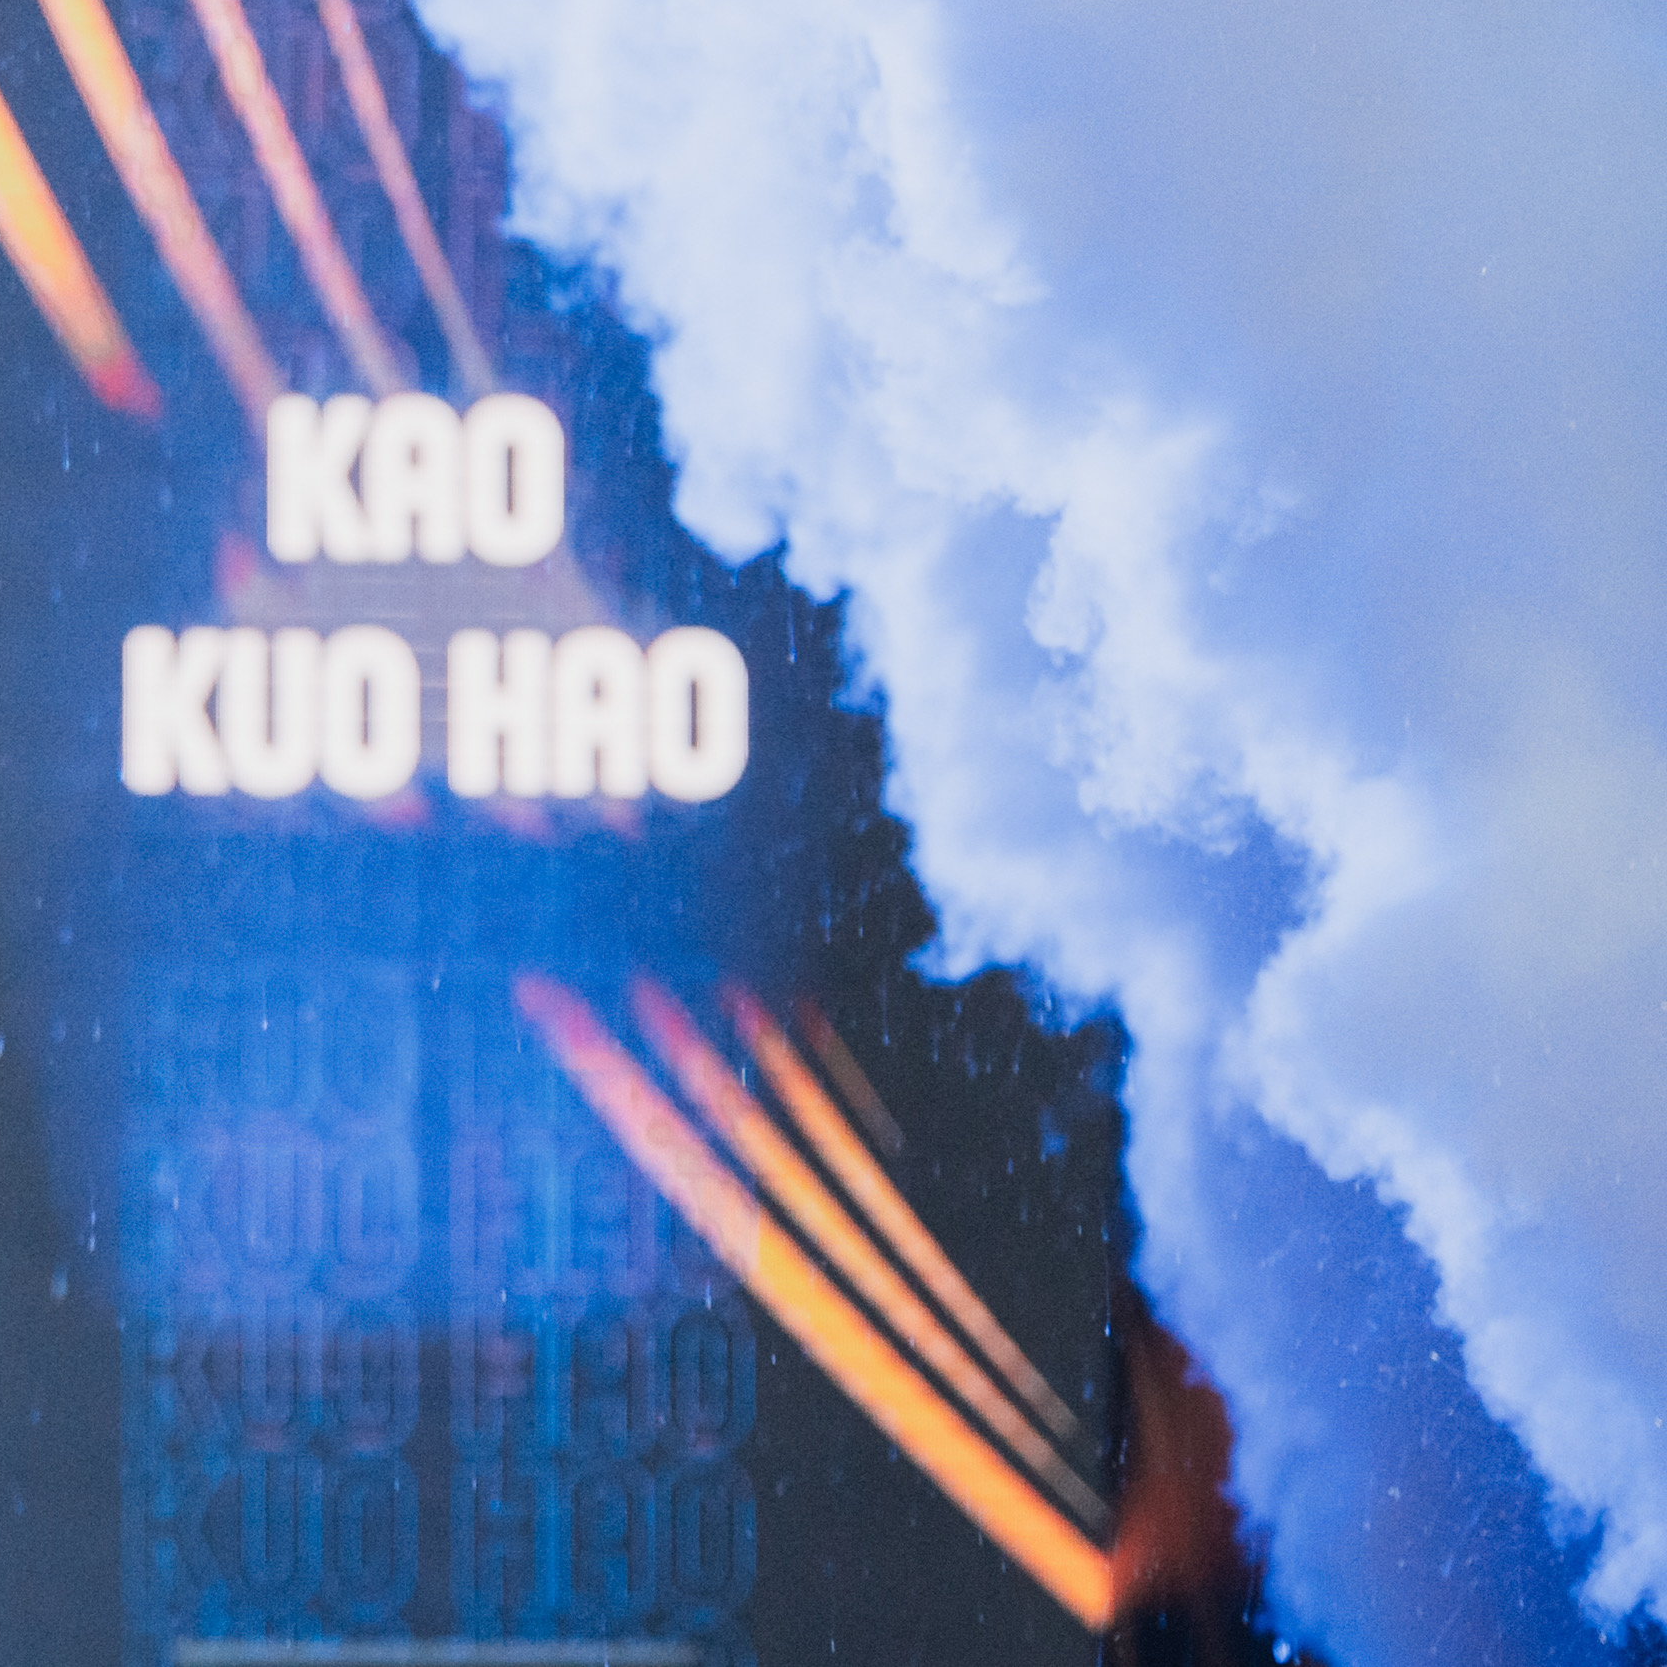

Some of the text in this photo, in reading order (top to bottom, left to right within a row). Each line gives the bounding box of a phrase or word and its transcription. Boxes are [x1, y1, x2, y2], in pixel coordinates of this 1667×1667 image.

[267, 392, 565, 567] KAO
[121, 624, 749, 803] KUO HAO
